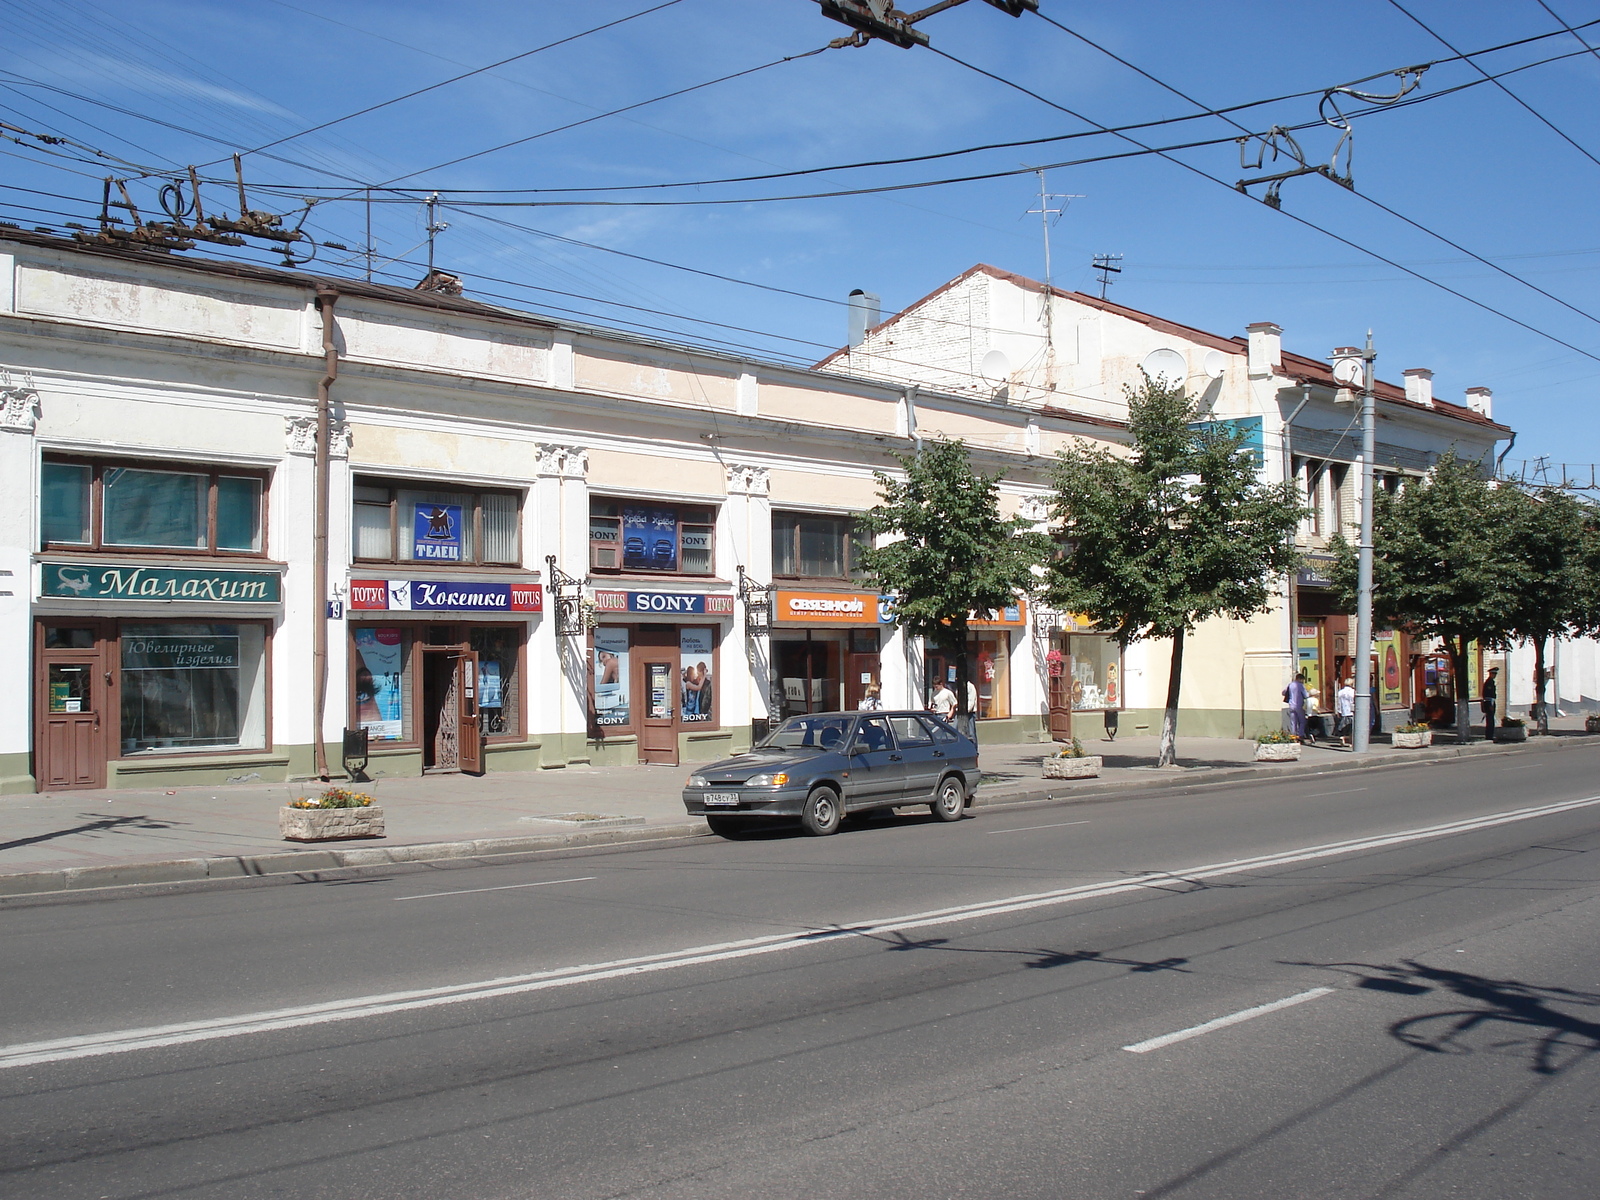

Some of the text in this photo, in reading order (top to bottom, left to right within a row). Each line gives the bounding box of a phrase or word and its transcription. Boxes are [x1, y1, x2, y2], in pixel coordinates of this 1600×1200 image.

[590, 531, 617, 540] SONY
[682, 537, 707, 545] SONY
[416, 544, 459, 561] ТЕЛЕЦ
[99, 567, 268, 600] Малахит
[353, 587, 385, 602] ТОТУС
[415, 584, 507, 606] Кокетка
[513, 591, 540, 605] TOTUS
[597, 593, 626, 609] TOTUS
[330, 602, 340, 618] 19
[636, 594, 697, 611] SONY
[789, 597, 863, 612] СВЯЗНОЙ
[128, 641, 214, 656] Ювелирные
[176, 655, 232, 667] изделия
[597, 717, 624, 725] SONY
[683, 713, 708, 722] SONY
